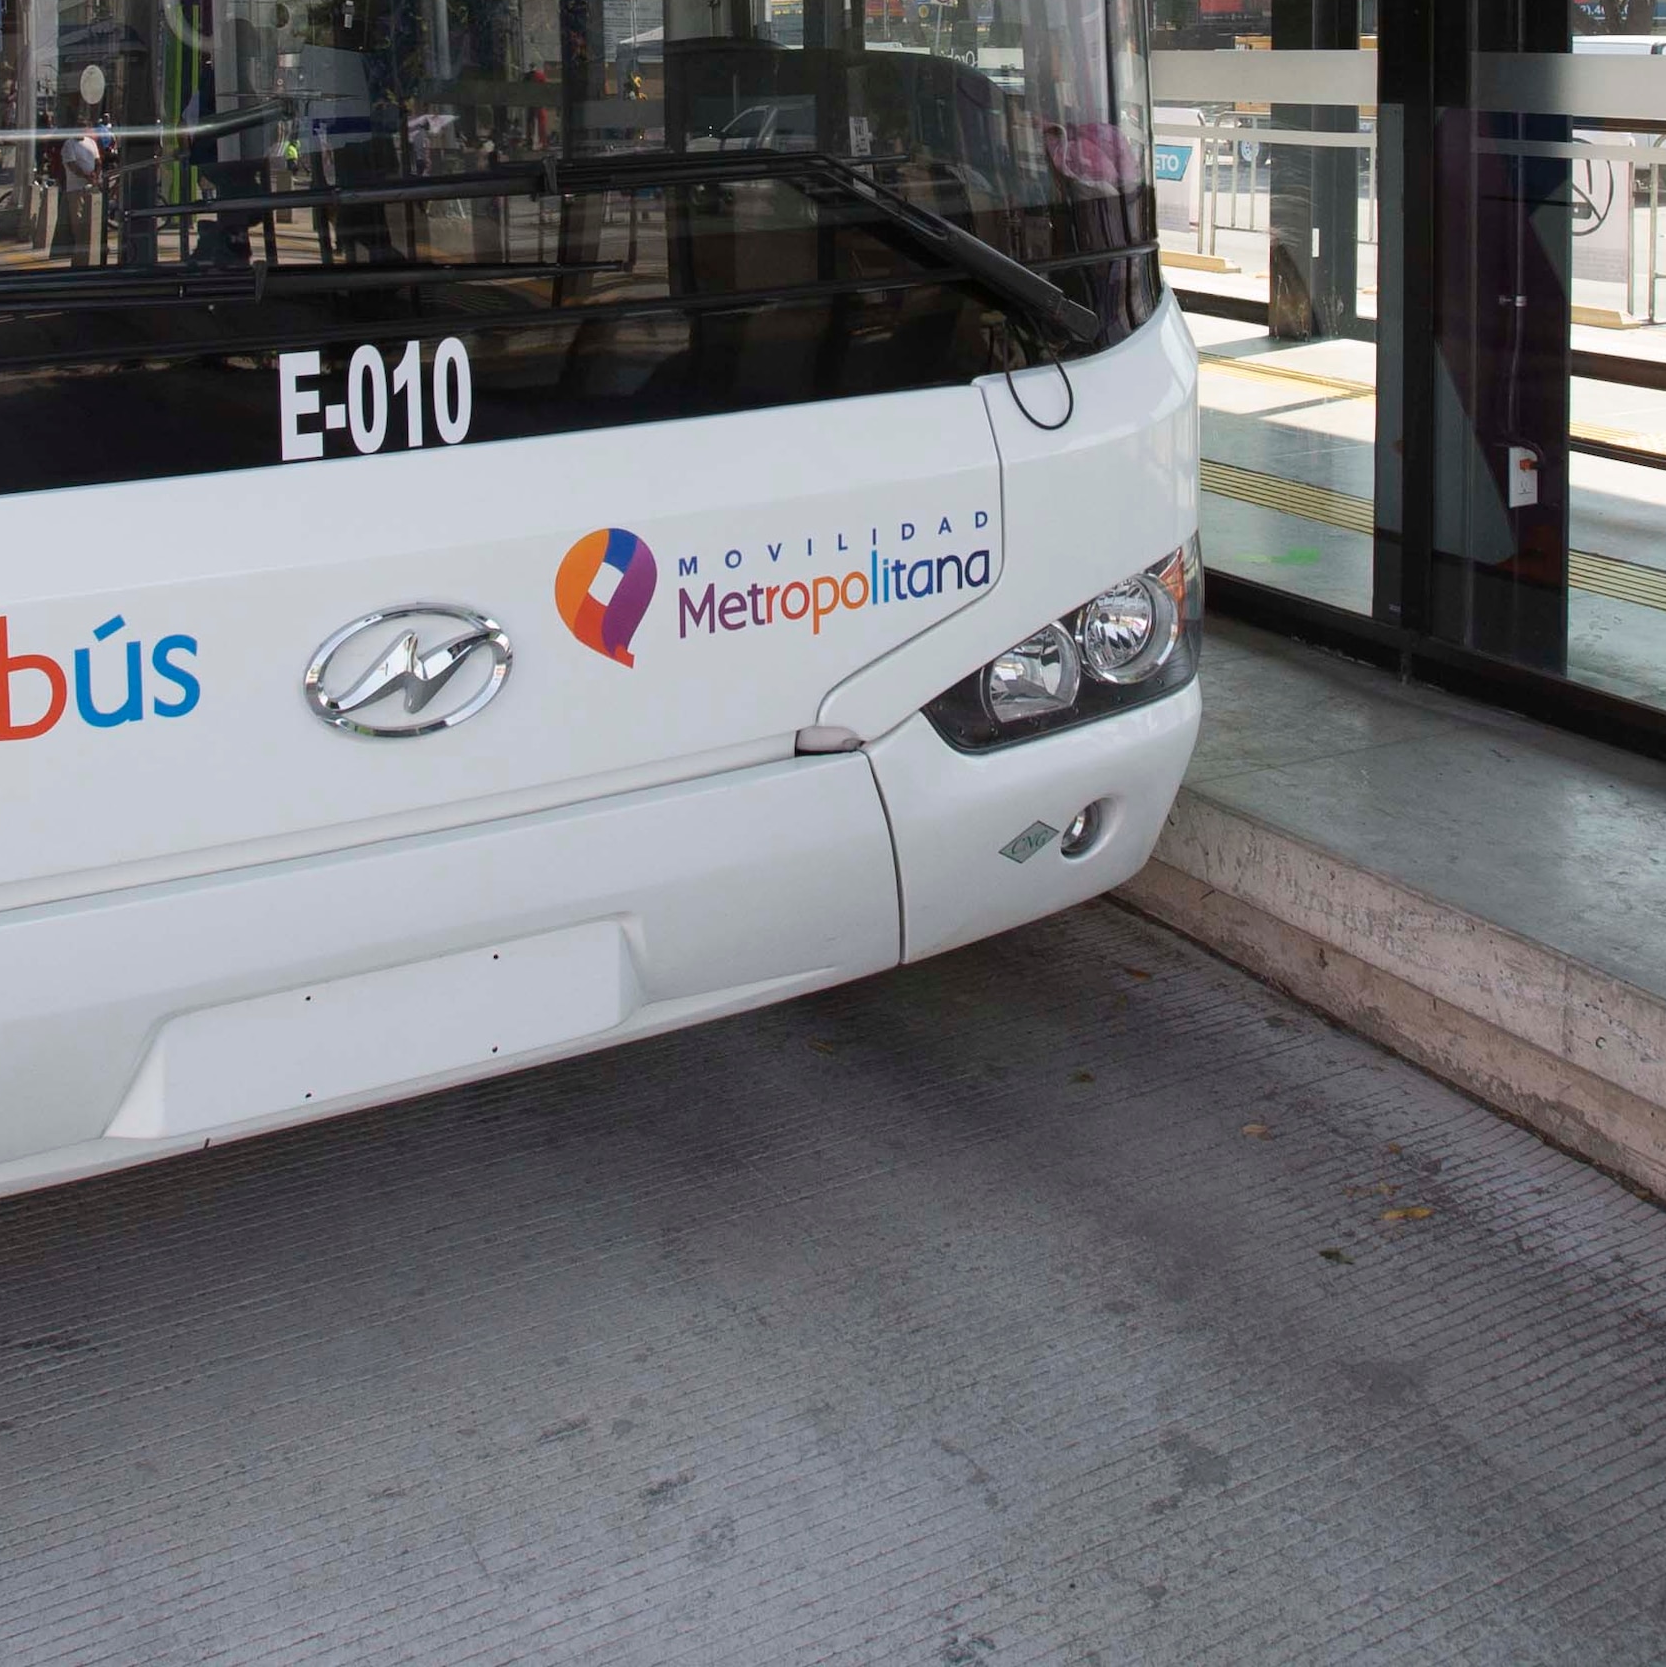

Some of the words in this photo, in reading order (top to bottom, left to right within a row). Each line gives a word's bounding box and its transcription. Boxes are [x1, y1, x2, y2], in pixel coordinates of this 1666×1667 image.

[278, 336, 472, 462] E-010
[677, 510, 991, 577] MOVILIDAD
[677, 547, 992, 640] Metropolitana
[1010, 827, 1050, 855] CNG
